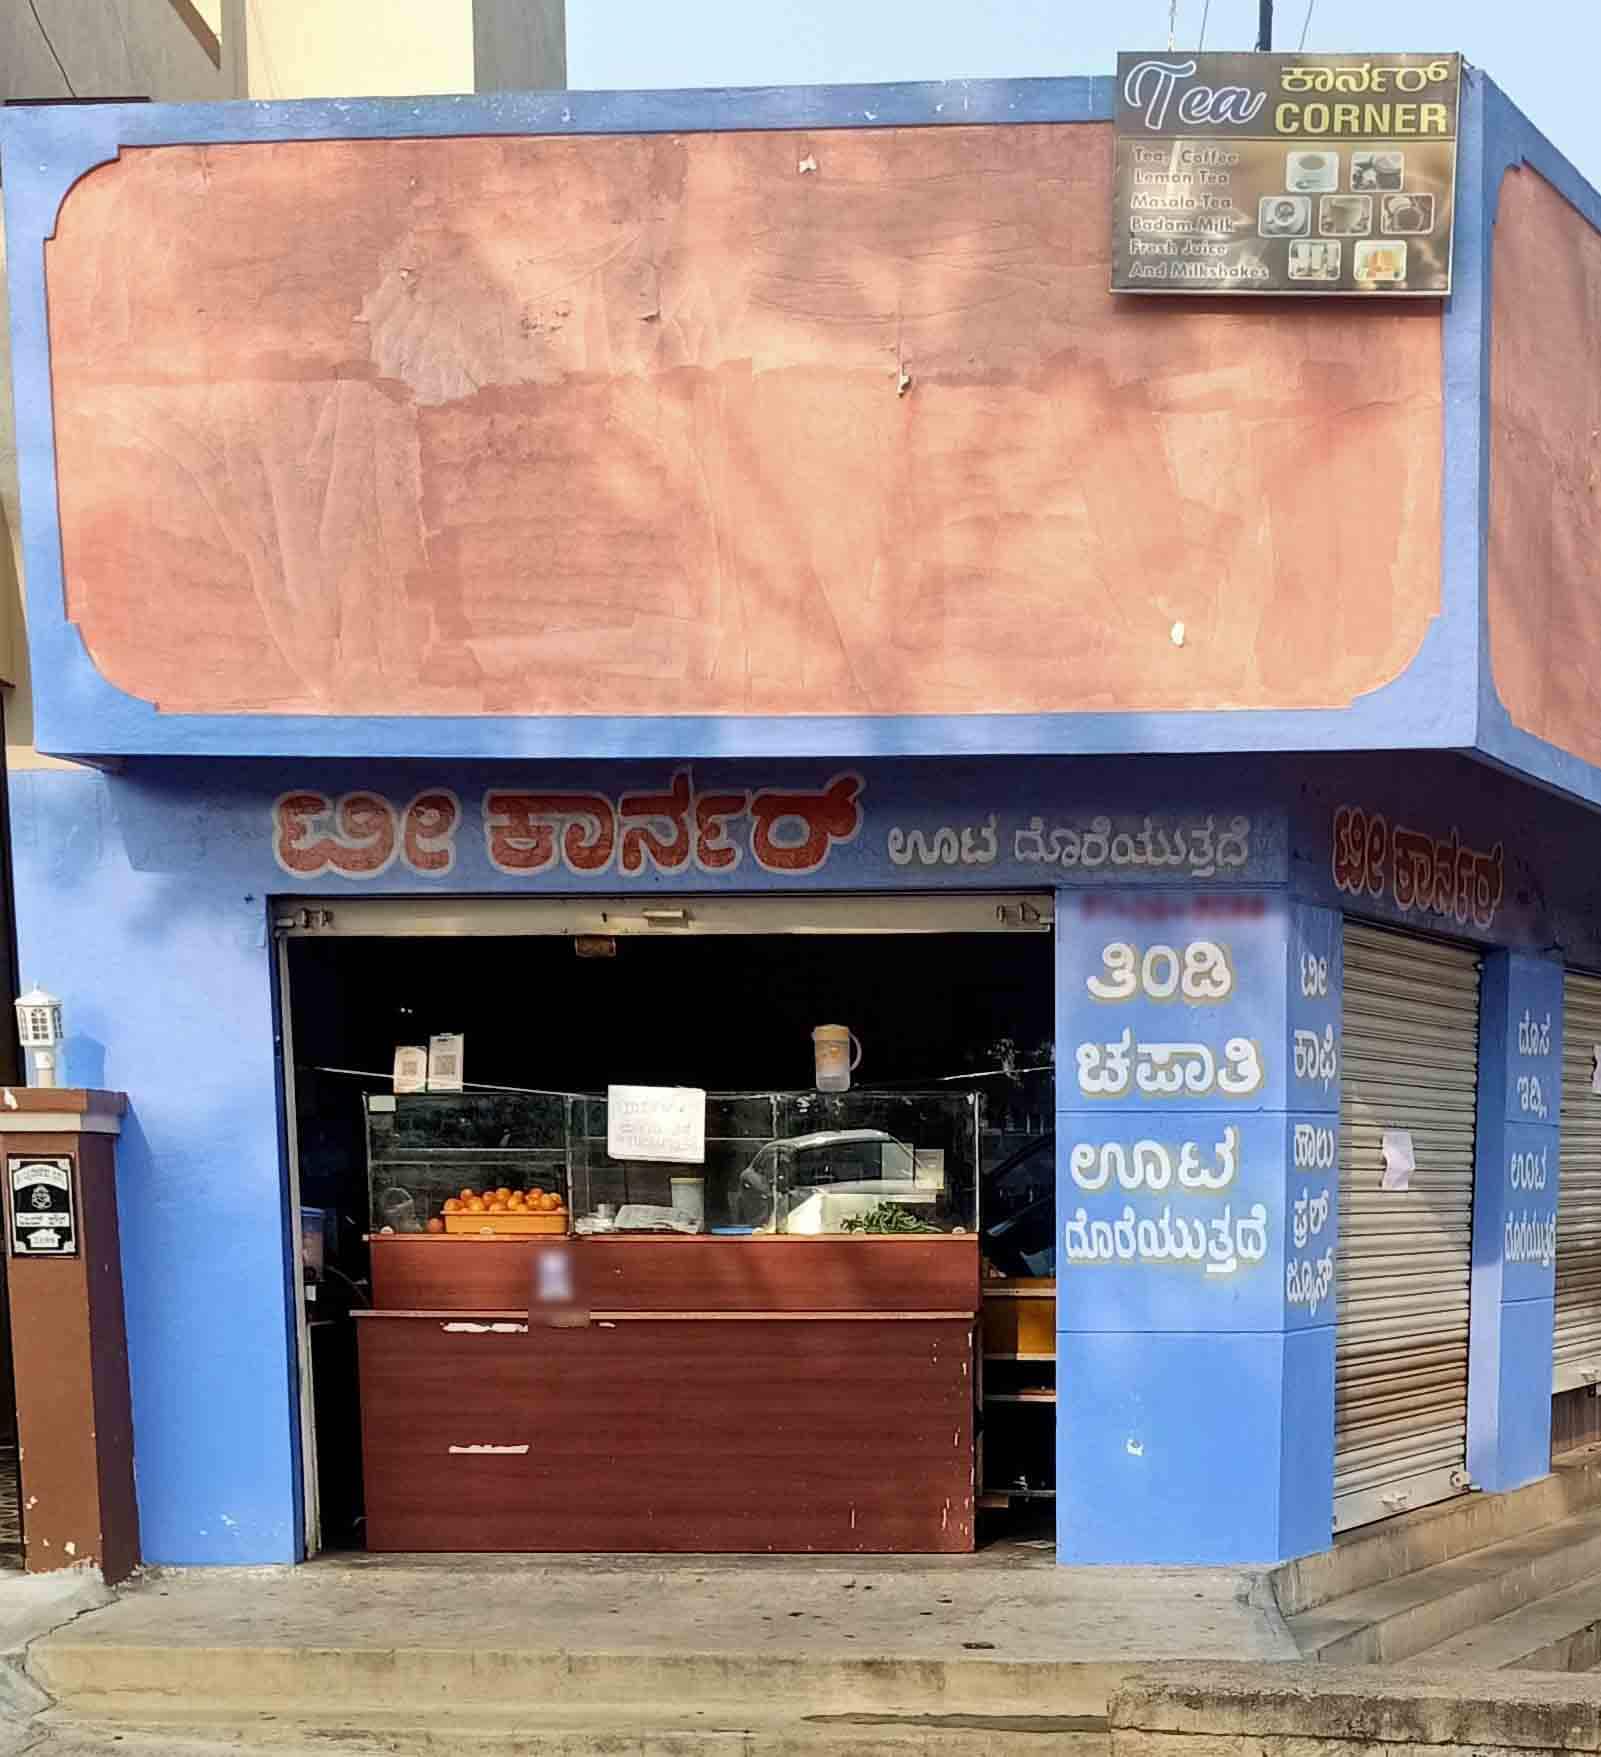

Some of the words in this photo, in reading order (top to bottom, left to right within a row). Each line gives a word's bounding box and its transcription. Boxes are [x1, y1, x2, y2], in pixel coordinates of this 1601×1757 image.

[1124, 60, 1267, 130] Tea
[1280, 60, 1449, 93] ಕಾರ್ನರ್
[1275, 103, 1448, 134] CORNER
[1135, 168, 1194, 184] Lemon
[1199, 169, 1230, 184] Tea
[1131, 192, 1196, 208] Masala
[1200, 193, 1232, 208] Tea
[1130, 216, 1193, 232] Badam
[1198, 216, 1233, 232] Milk
[1129, 239, 1178, 255] Fresh
[1128, 261, 1168, 278] And
[1170, 261, 1270, 280] Milkshakes
[273, 790, 461, 878] ಟೀ
[482, 766, 865, 876] ಕಾರ್ನರ್
[887, 813, 998, 865] ಊಟ
[1014, 814, 1250, 877] ದೊರೆಯುತ್ತದೆ
[1392, 826, 1504, 929] ಕಾರ್ನರ್
[1087, 942, 1232, 998] ತಿಂಡಿ
[1301, 952, 1328, 996] ಟೀ
[1076, 1026, 1262, 1094] ಚಪಾತಿ
[1070, 1126, 1238, 1190] ಊಟ
[1511, 1145, 1546, 1190] ಊಟ
[1065, 1203, 1267, 1273] ದೊರೆಯುತ್ತದೆ
